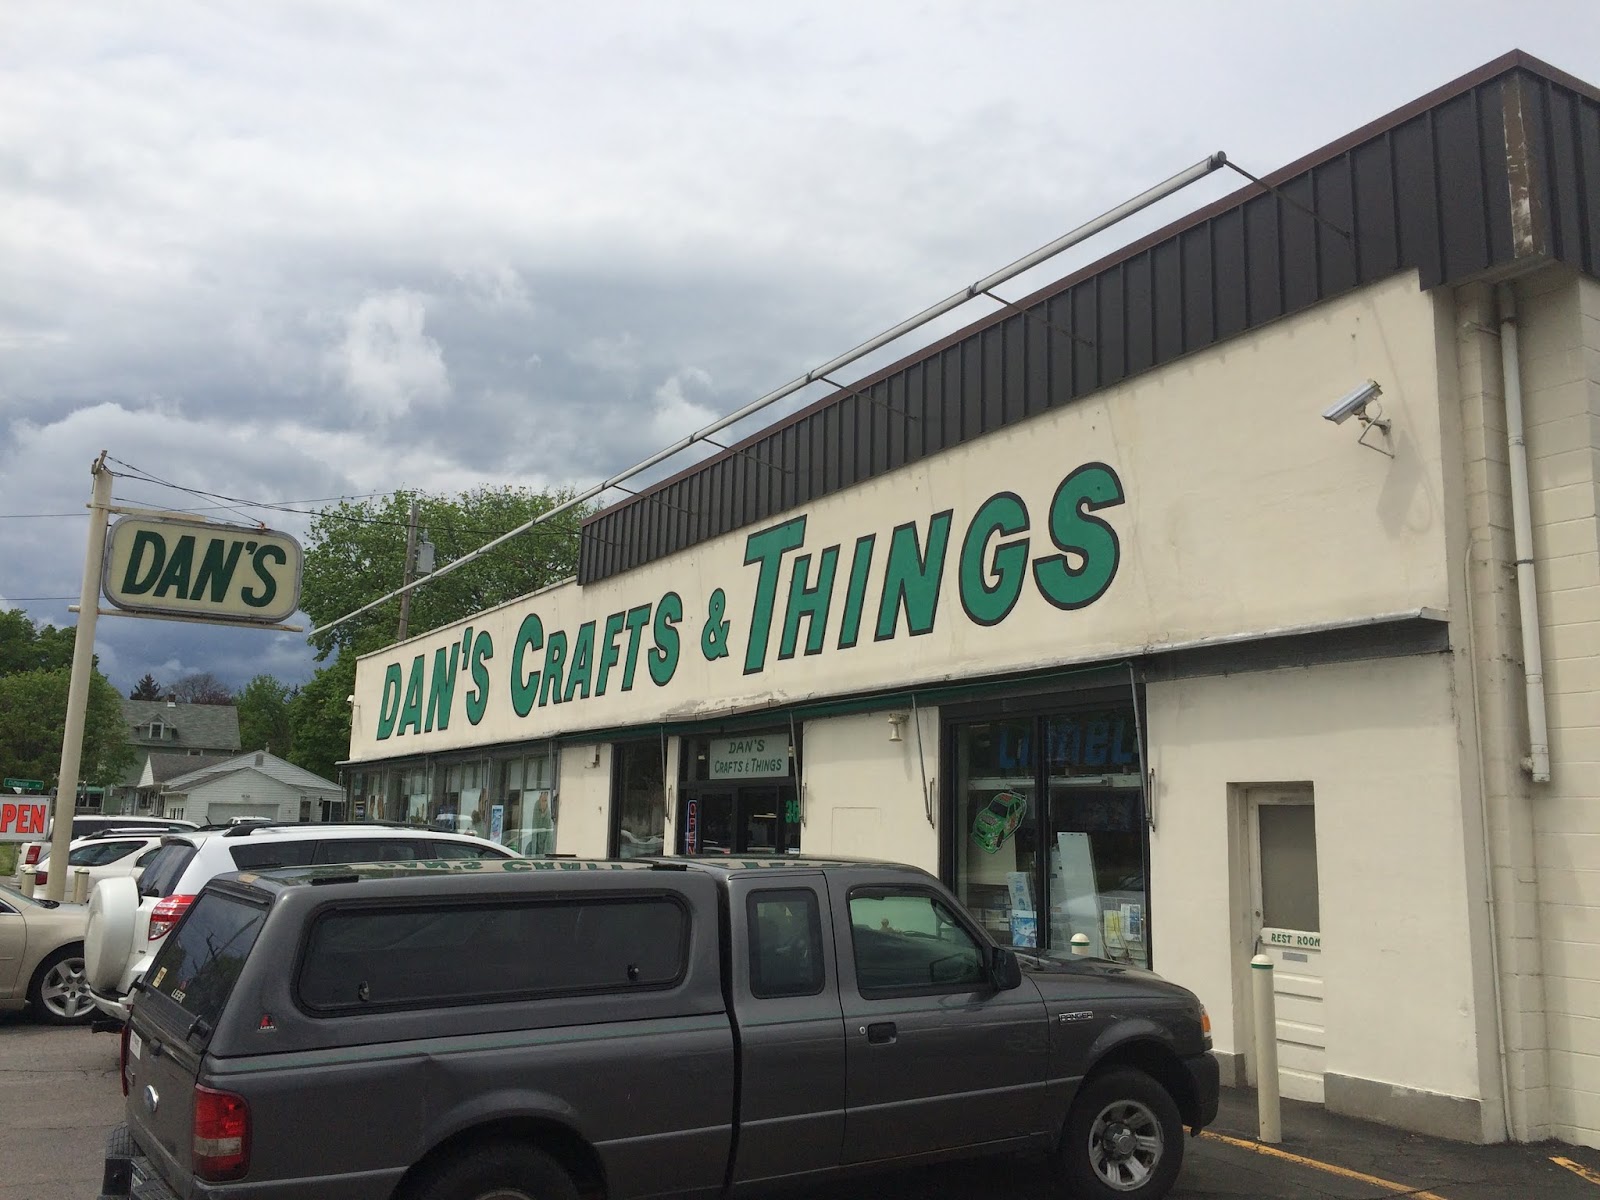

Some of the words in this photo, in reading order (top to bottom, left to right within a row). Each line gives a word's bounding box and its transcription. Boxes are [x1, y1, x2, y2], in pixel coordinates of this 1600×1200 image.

[121, 530, 287, 608] DAN'S
[376, 626, 494, 741] DAN'S
[510, 591, 684, 718] CRAFTS
[701, 587, 730, 661] &
[743, 461, 1126, 675] THINGS
[728, 739, 766, 754] DAN'S
[714, 760, 743, 774] CRAFTS
[751, 758, 783, 773] THINGS
[0, 803, 46, 834] PEN
[1271, 932, 1292, 944] REST
[1297, 935, 1321, 947] ROOM
[170, 988, 186, 1004] LEER
[1060, 1011, 1093, 1022] RANGER
